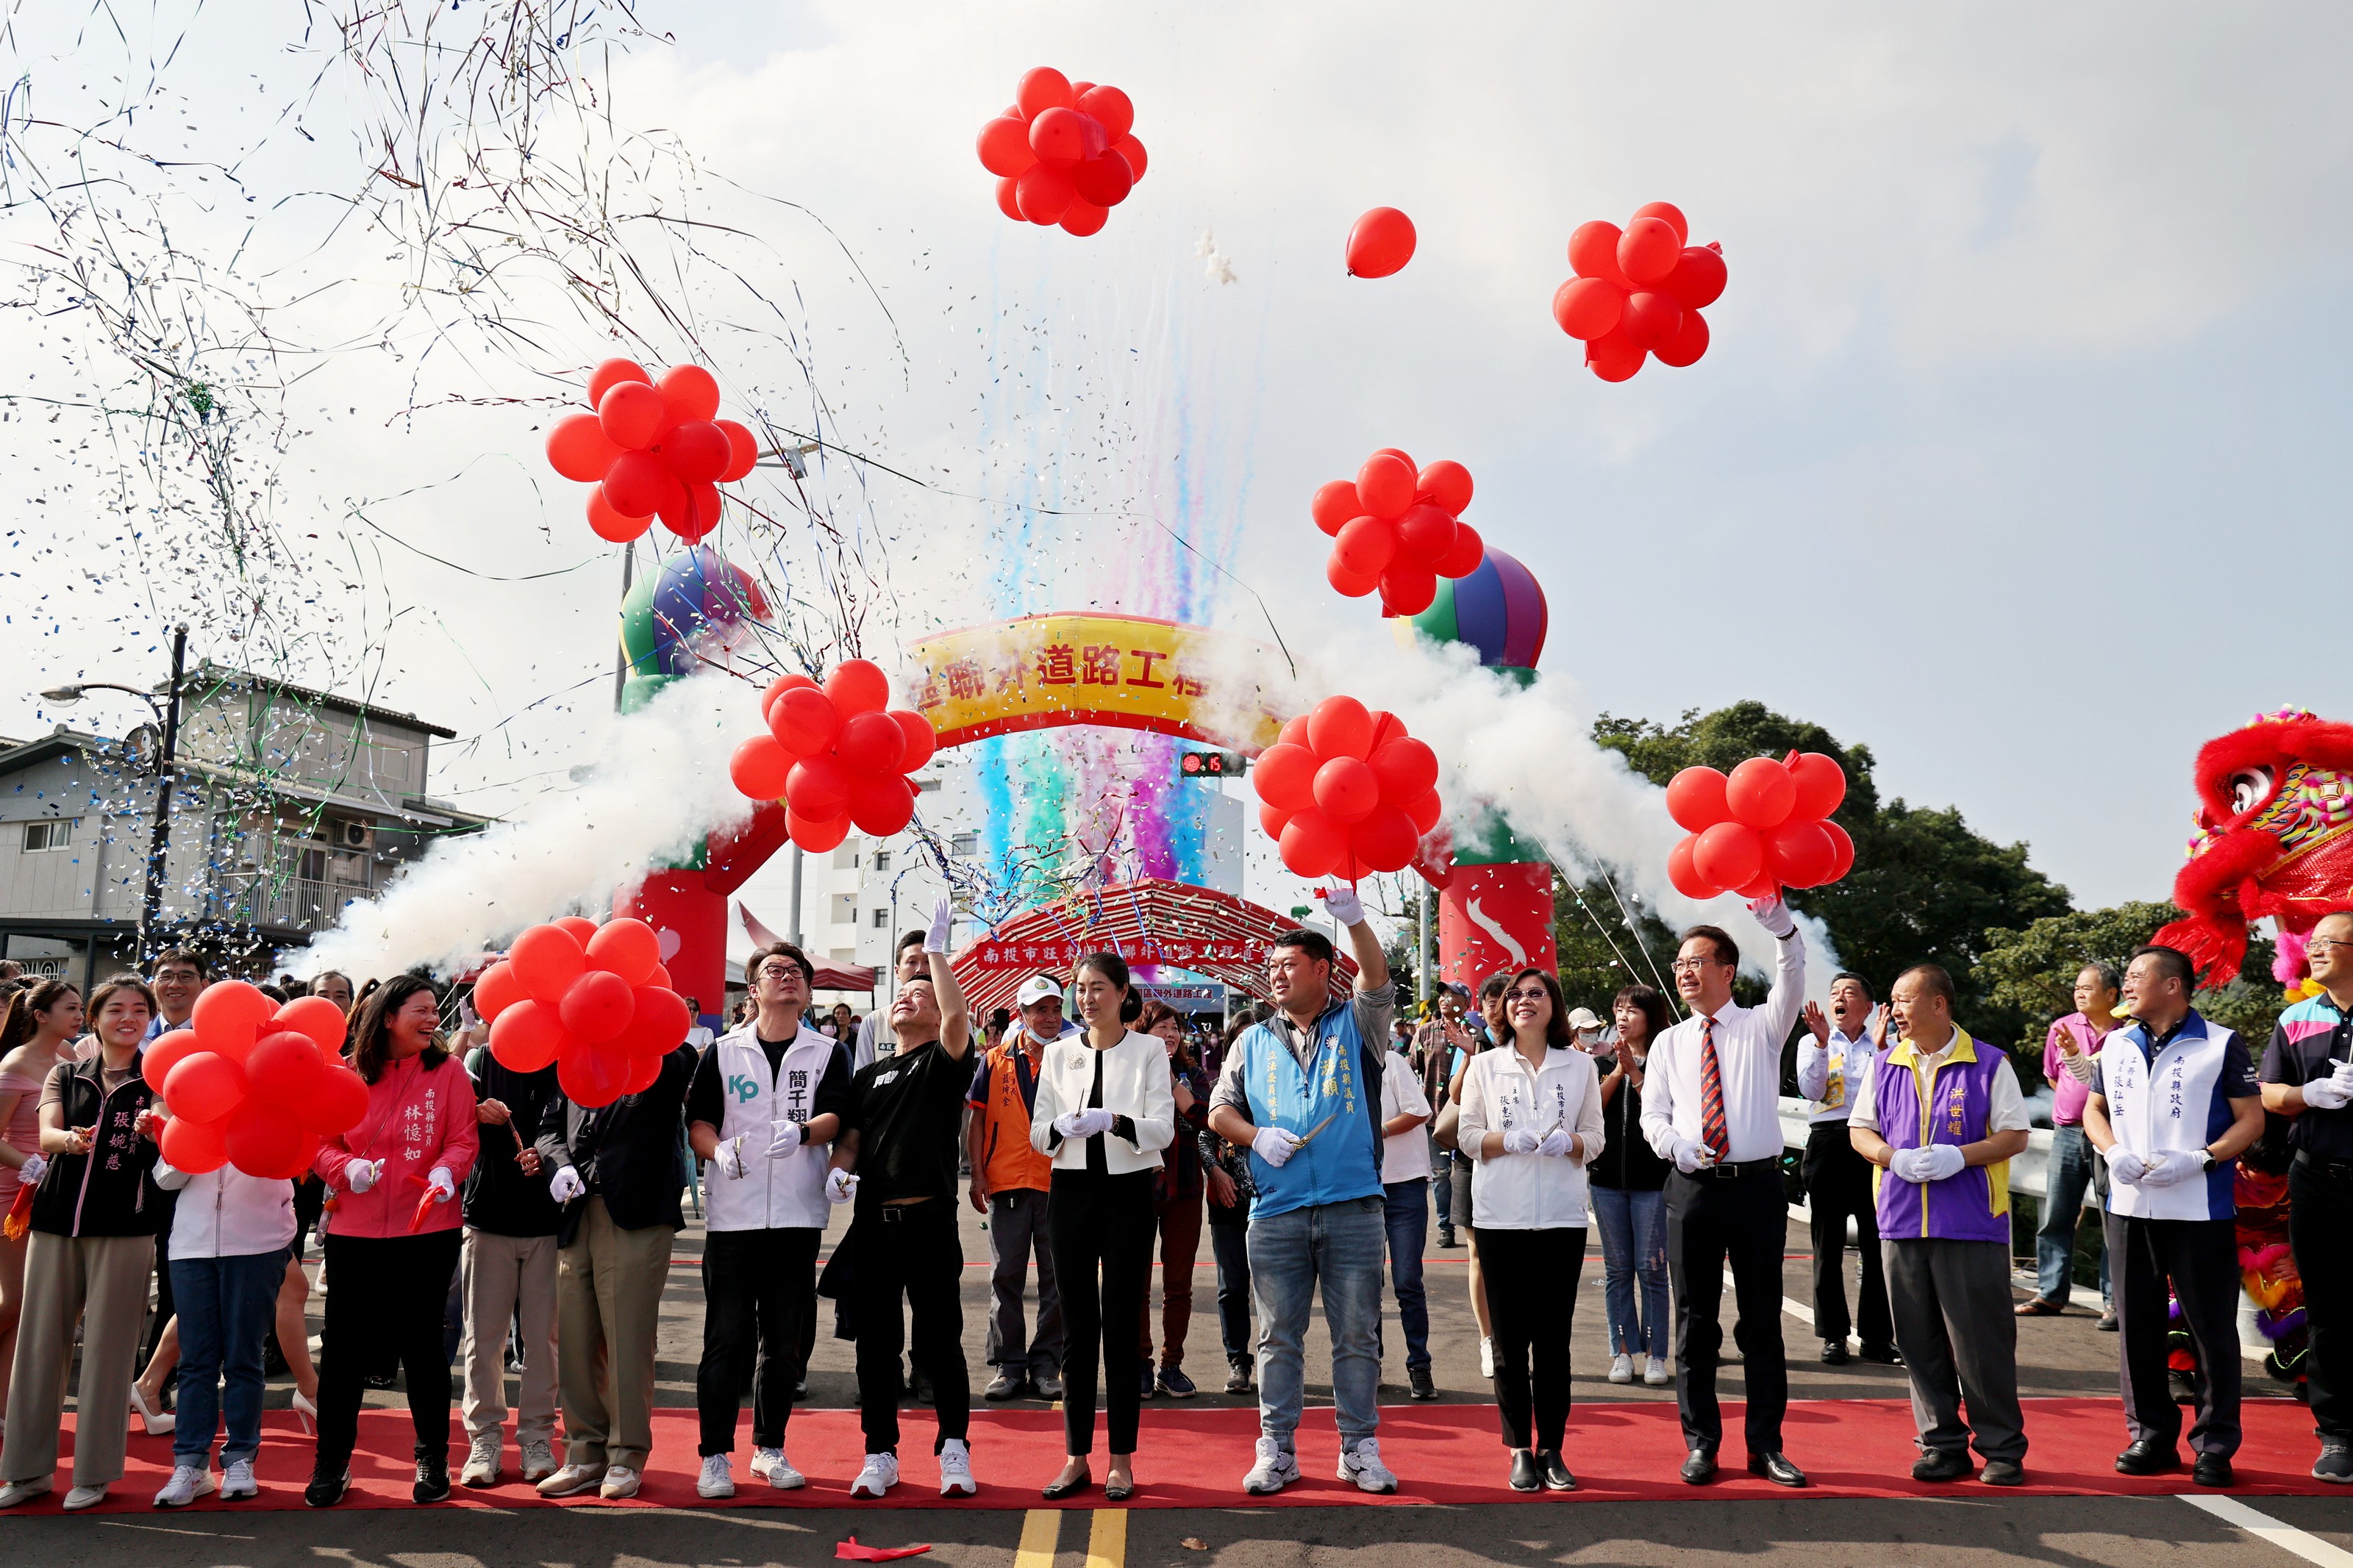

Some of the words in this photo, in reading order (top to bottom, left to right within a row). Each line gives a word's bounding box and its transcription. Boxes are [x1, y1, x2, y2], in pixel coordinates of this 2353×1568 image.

[1210, 756, 1221, 771] 15
[788, 1070, 807, 1123] 簡千翔
[1267, 1050, 1278, 1128] 立法委員候選
[1338, 1045, 1354, 1114] 南投縣議員
[1512, 1086, 1519, 1104] 主席
[2171, 1056, 2185, 1118] 南投縣政府
[105, 1111, 131, 1170] 張婉慈
[128, 1095, 145, 1155] 南議員
[404, 1104, 423, 1161] 林憶如
[425, 1089, 435, 1147] 南投縣議員
